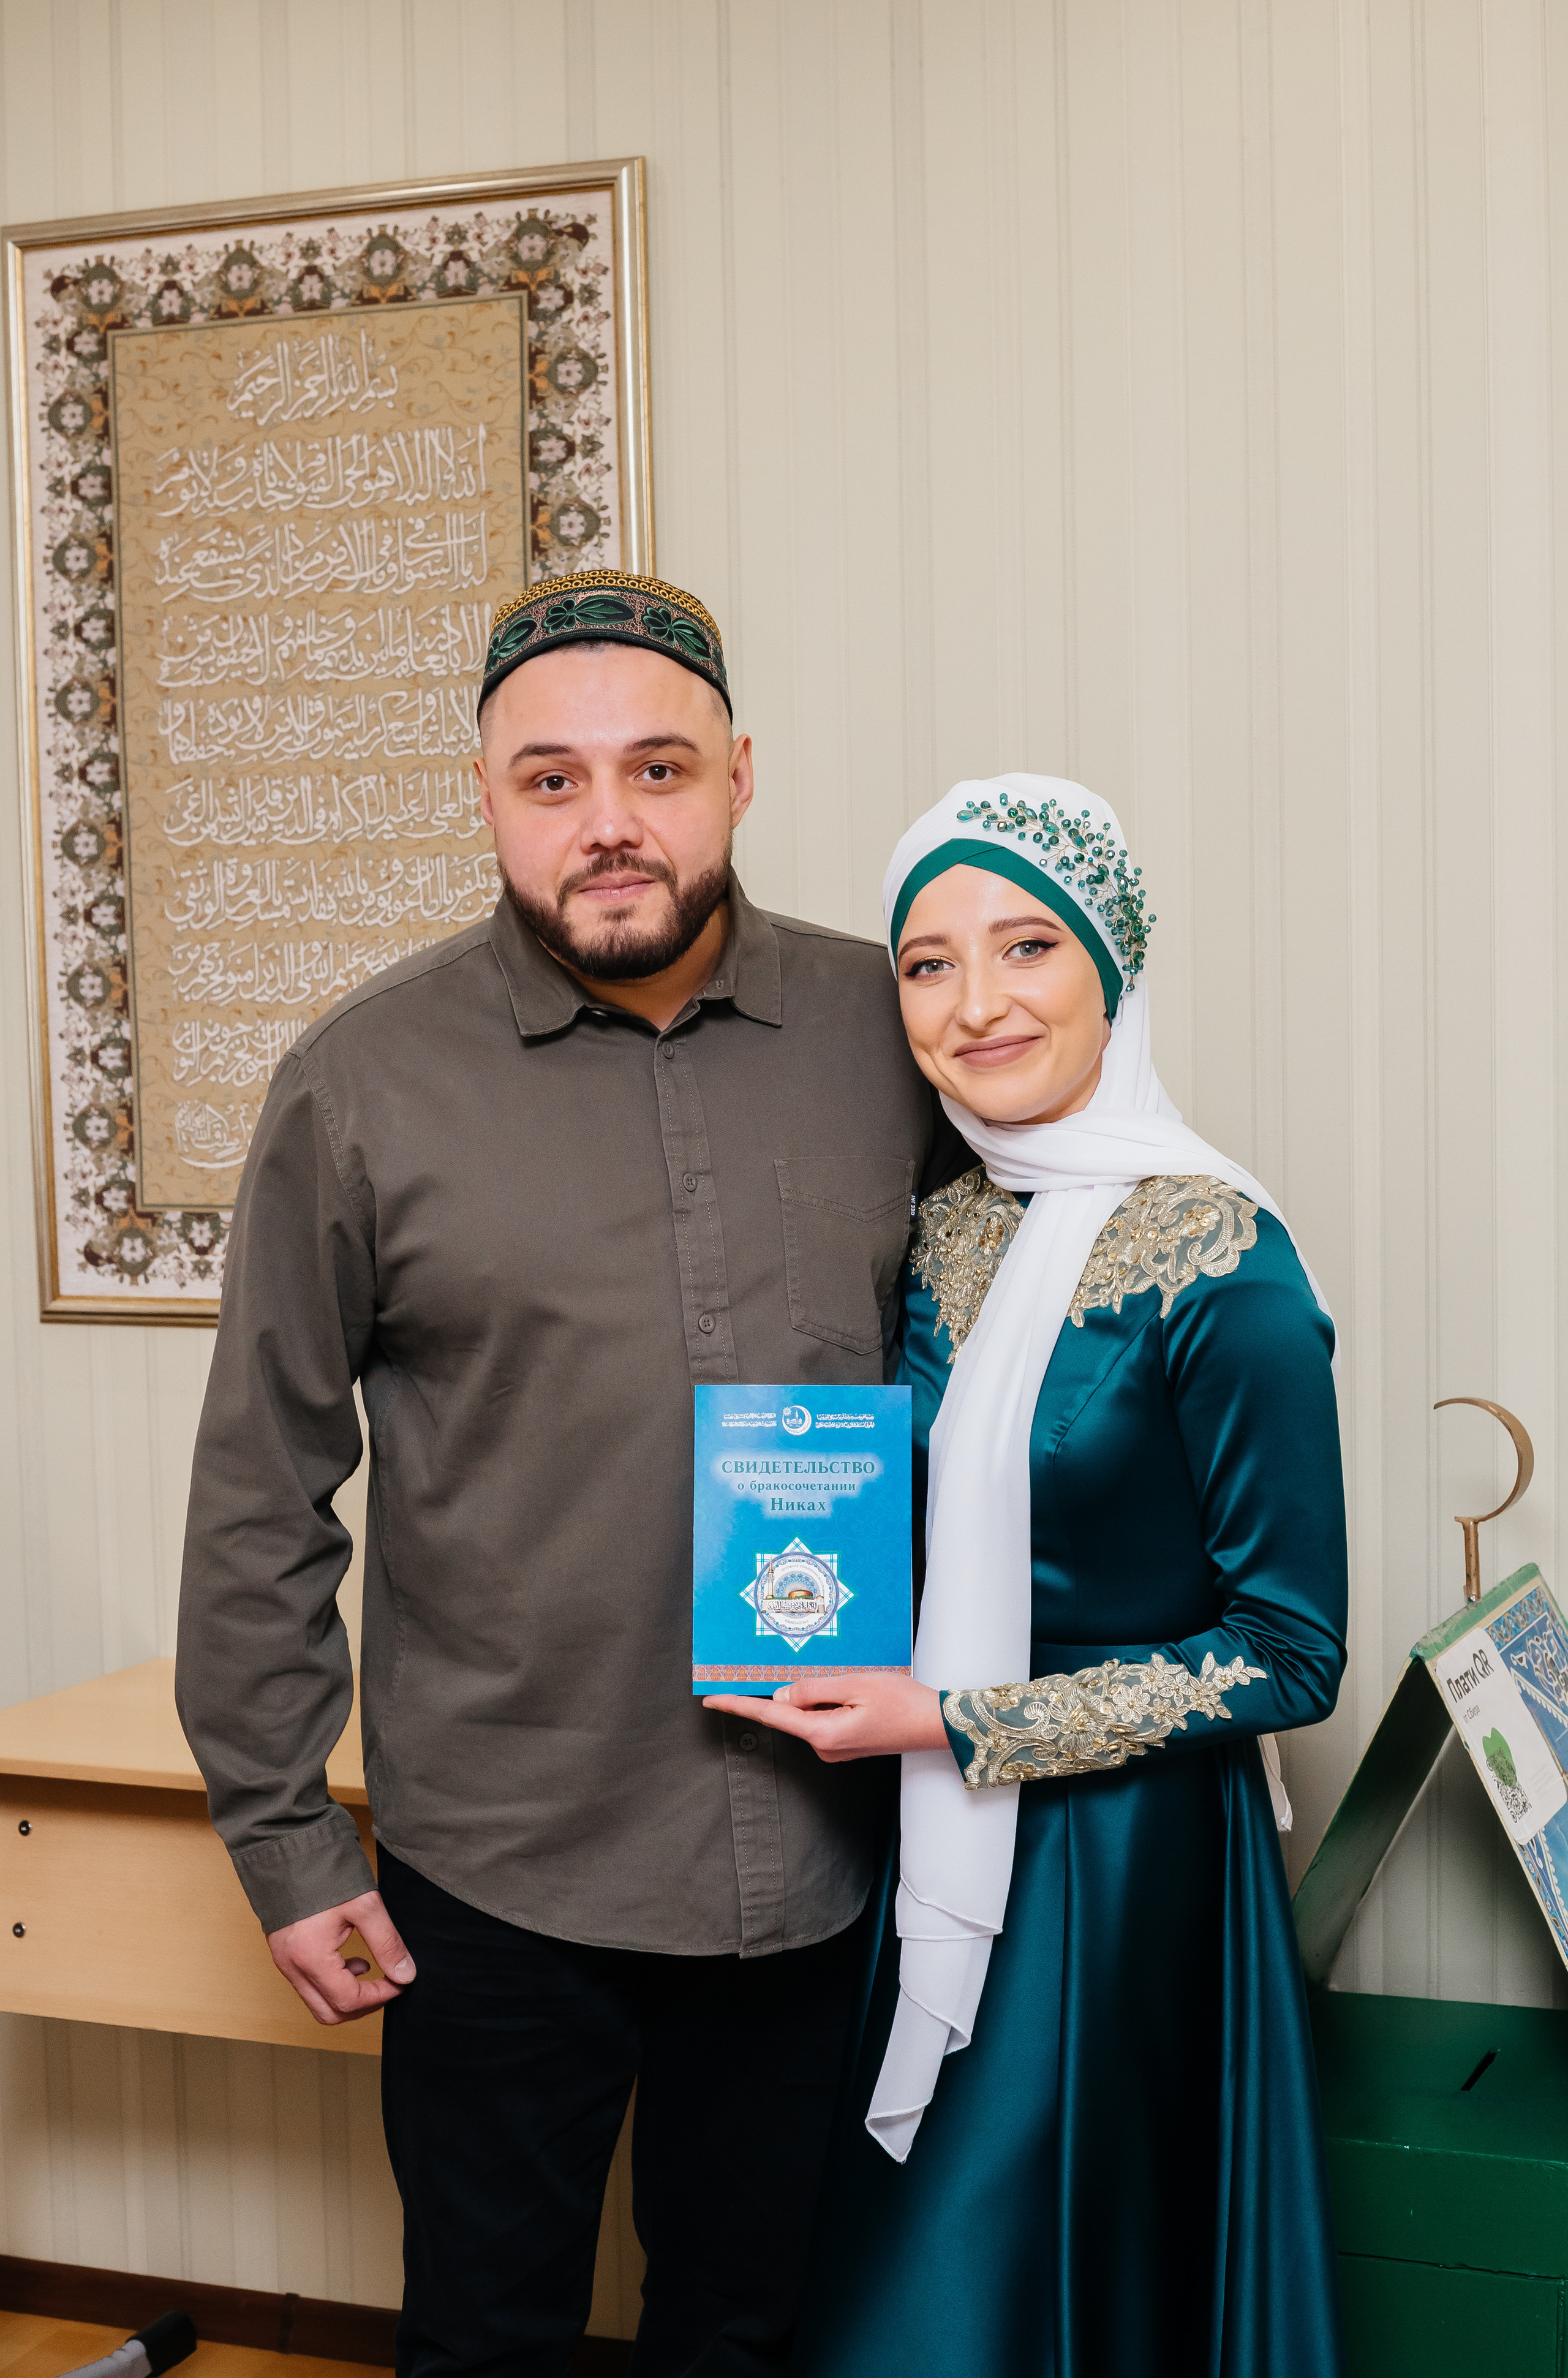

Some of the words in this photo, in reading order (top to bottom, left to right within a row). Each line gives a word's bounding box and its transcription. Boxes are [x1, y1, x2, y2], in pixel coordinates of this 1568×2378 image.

[722, 1460, 875, 1475] СВИДЕТЕЛЬСТВО
[750, 1480, 856, 1493] бракосочетании
[771, 1497, 826, 1511] Никах
[1446, 1666, 1480, 1704] Плати
[1472, 1649, 1494, 1679] QR
